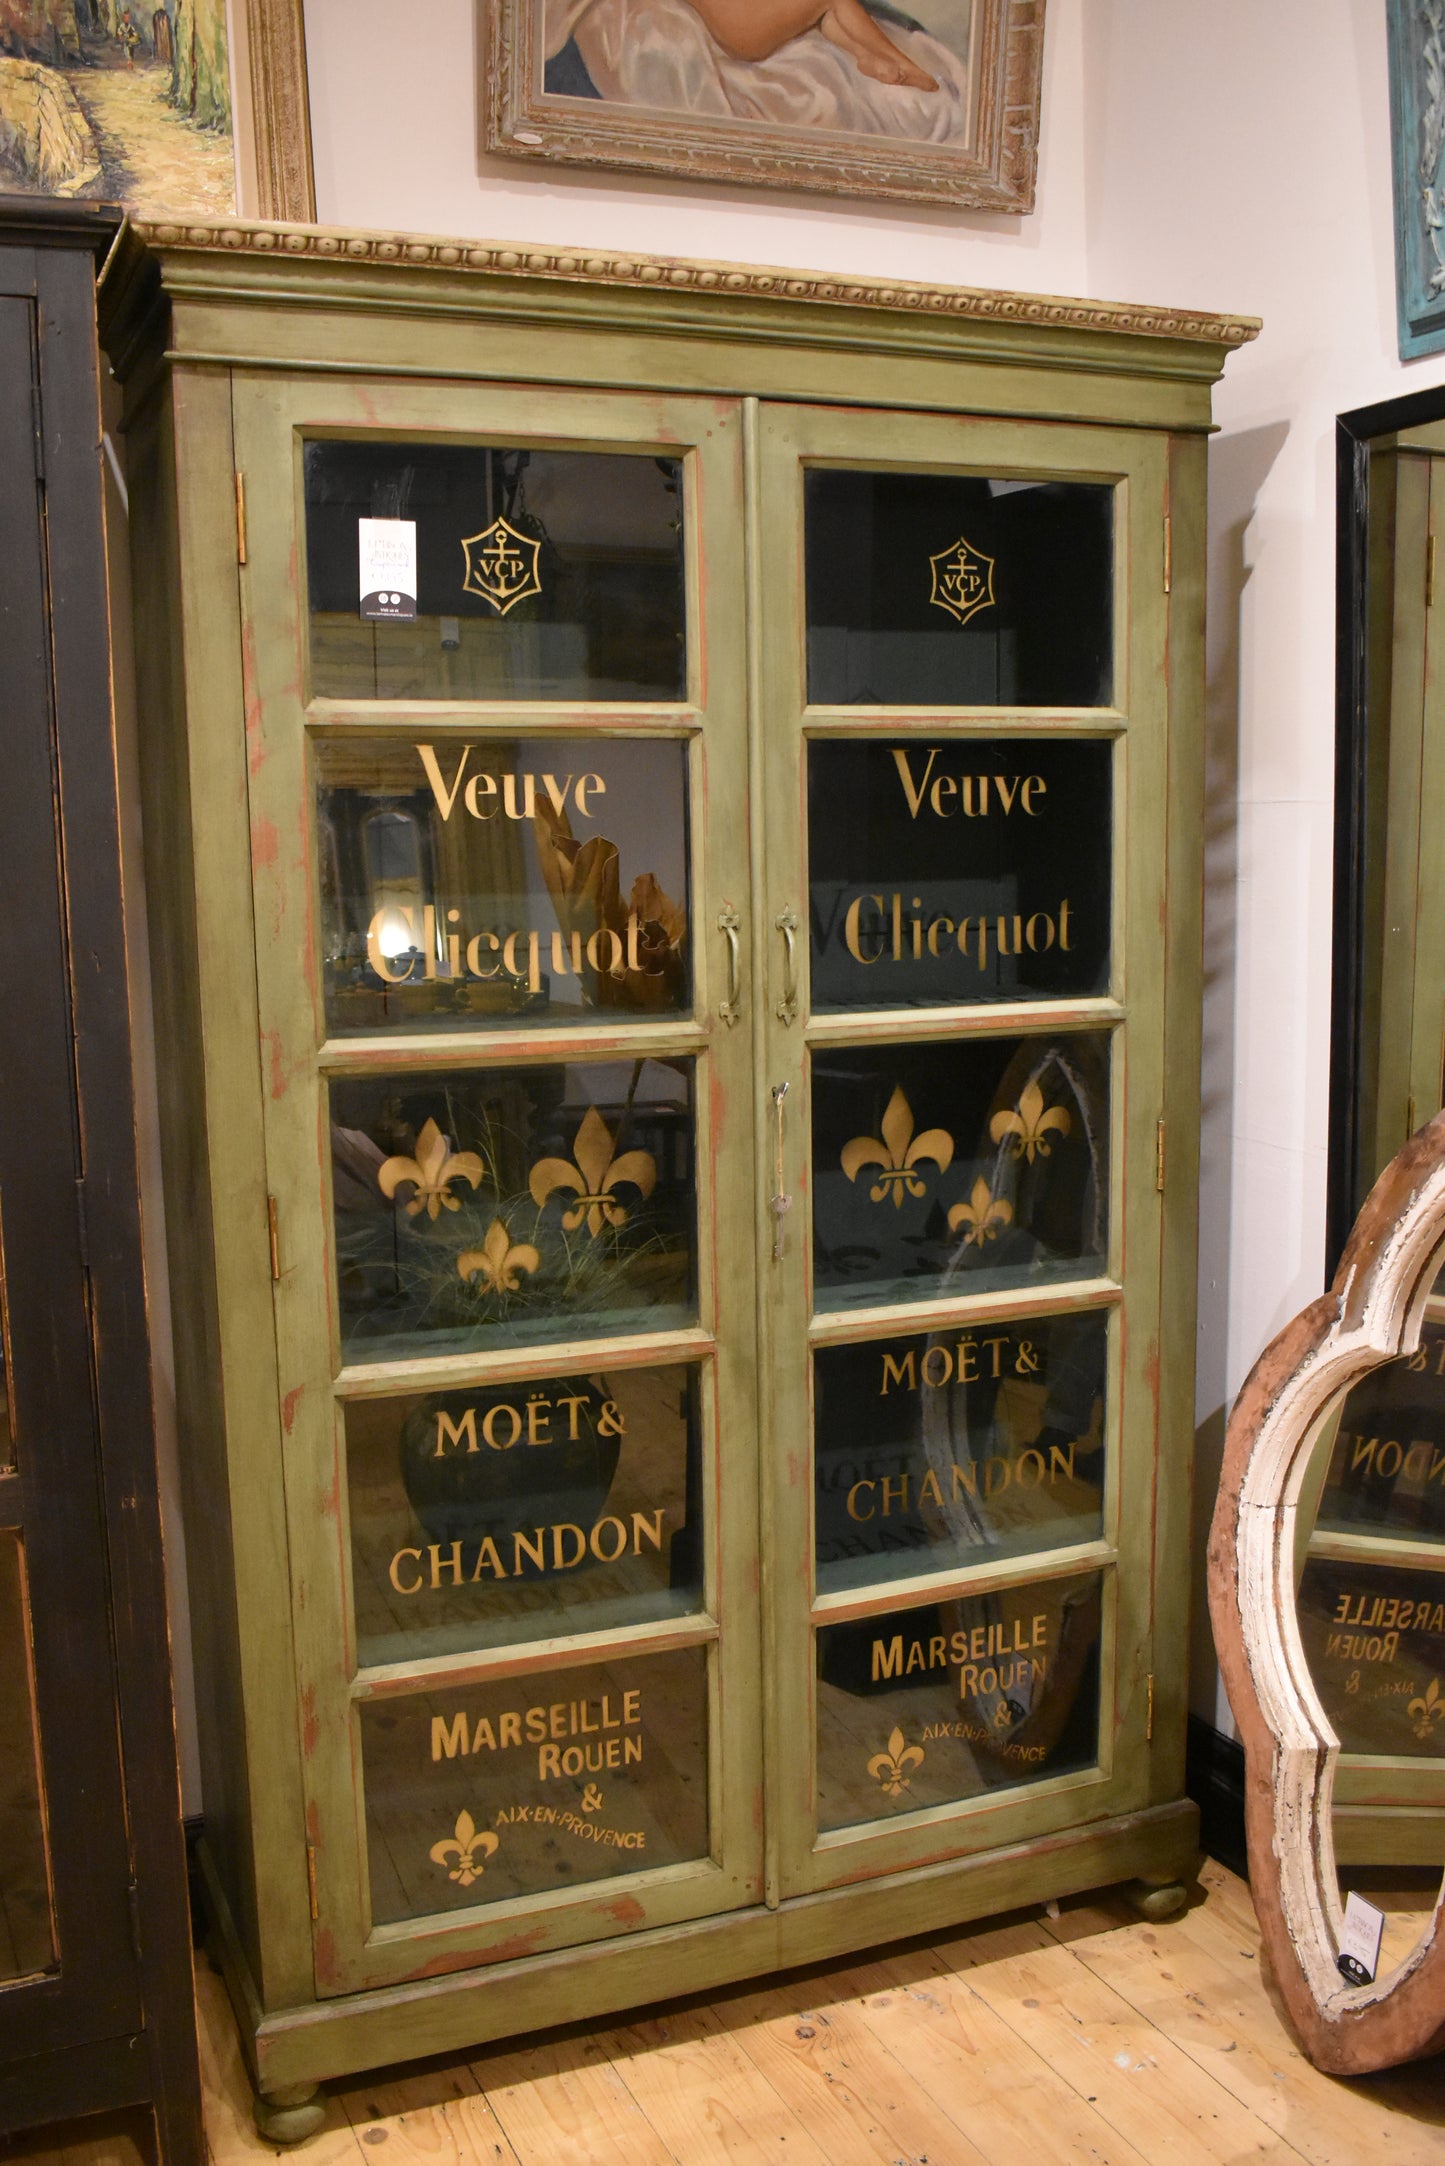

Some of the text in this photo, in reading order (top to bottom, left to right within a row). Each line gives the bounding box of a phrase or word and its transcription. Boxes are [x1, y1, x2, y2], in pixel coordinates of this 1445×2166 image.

[477, 558, 525, 580] VCP
[943, 572, 982, 594] VCP
[414, 744, 606, 822] Veuve
[886, 748, 1047, 820] Veuve
[367, 903, 646, 994] Clicquot
[844, 892, 1075, 972] Clicquot
[880, 1334, 1042, 1396] MOËT &
[433, 1393, 629, 1458] MOËT &
[846, 1441, 1078, 1523] CHANDON
[389, 1508, 666, 1595] CHANDON
[993, 1699, 1013, 1728] &
[582, 1782, 604, 1813] &
